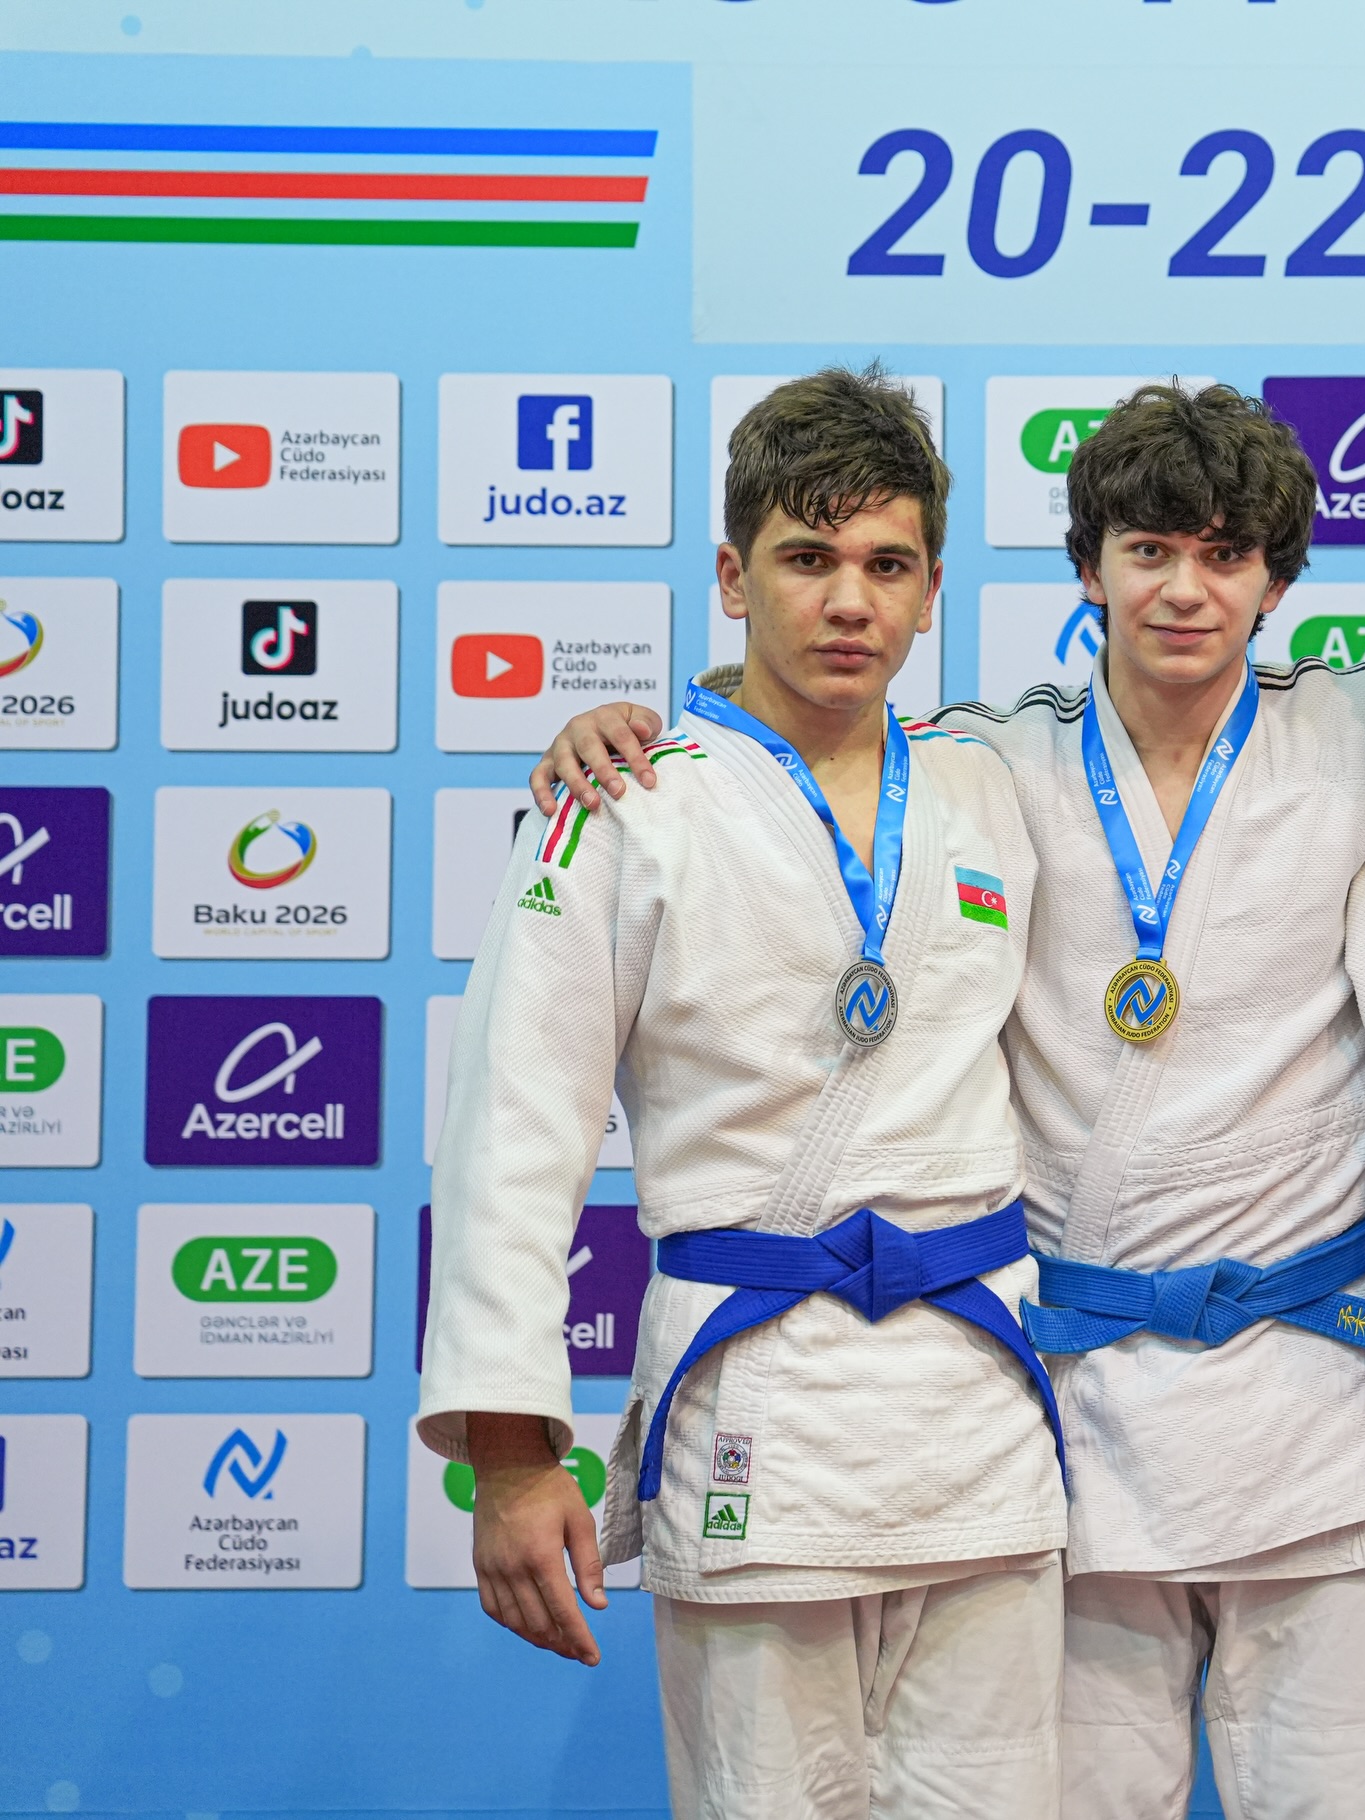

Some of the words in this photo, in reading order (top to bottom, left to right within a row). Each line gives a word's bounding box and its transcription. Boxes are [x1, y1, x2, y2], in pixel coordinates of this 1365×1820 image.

[281, 431, 381, 448] Azərbaycan
[280, 447, 326, 463] Cüdo
[280, 466, 386, 484] Federasiyası
[484, 486, 626, 522] judo.az
[554, 640, 651, 659] Azərbaycan
[552, 657, 597, 672] Cüdo
[552, 675, 656, 693] Federasiyası
[3, 695, 75, 715] 2026
[219, 692, 338, 727] judoaz
[194, 905, 266, 924] Baku
[276, 906, 347, 924] 2026
[517, 897, 562, 916] adidas
[181, 1104, 344, 1140] Azercell
[201, 1249, 308, 1291] AZE
[200, 1316, 279, 1329] GƏNCLƏR
[286, 1316, 307, 1328] VƏ
[200, 1330, 253, 1344] İDMAN
[190, 1516, 298, 1534] Azərbaycan
[706, 1520, 742, 1531] adidas
[218, 1534, 267, 1551] Cüdo
[184, 1555, 300, 1573] Federasiyası
